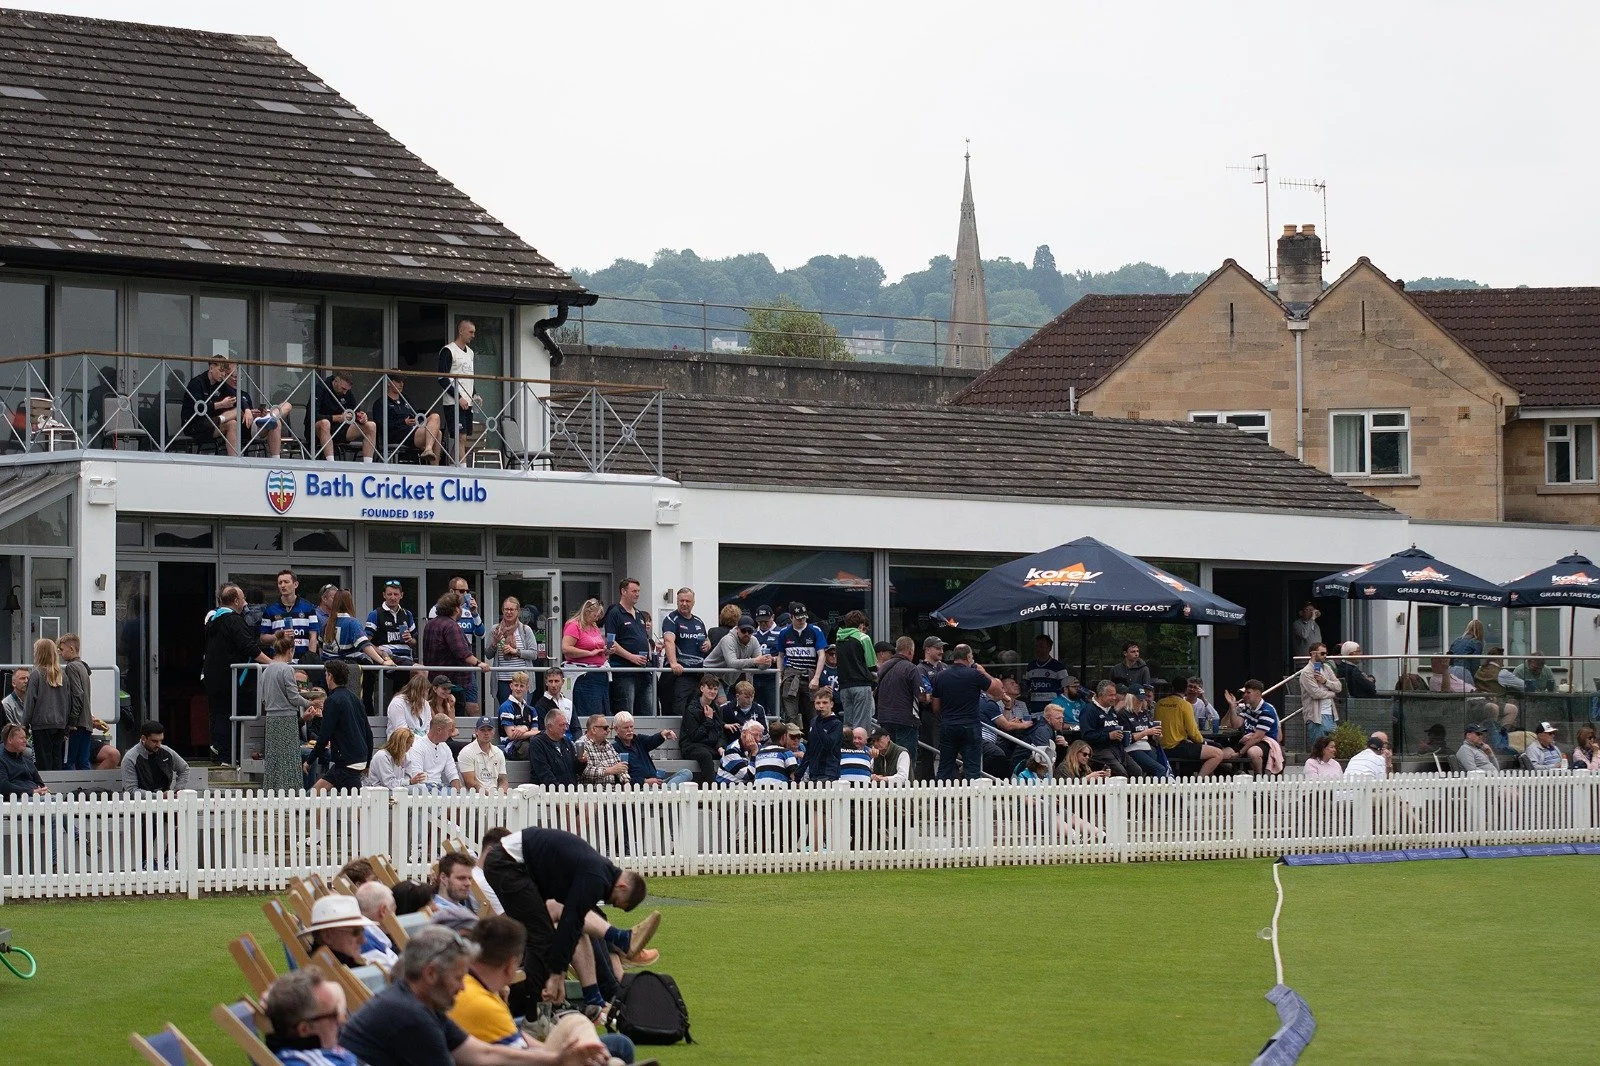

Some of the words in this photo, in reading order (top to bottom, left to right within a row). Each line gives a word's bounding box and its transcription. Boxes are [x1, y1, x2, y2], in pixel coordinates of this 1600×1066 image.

[306, 473, 354, 497] Bath
[361, 475, 435, 501] Cricket
[441, 479, 487, 502] Club
[361, 508, 409, 519] FOUNDED
[412, 510, 435, 520] 1859
[1025, 567, 1104, 580] korev
[1426, 588, 1450, 596] TASTE
[1476, 593, 1503, 602] COAST
[1020, 602, 1048, 616] GRAB
[1058, 602, 1091, 611] TASTE
[1093, 603, 1109, 611] OF
